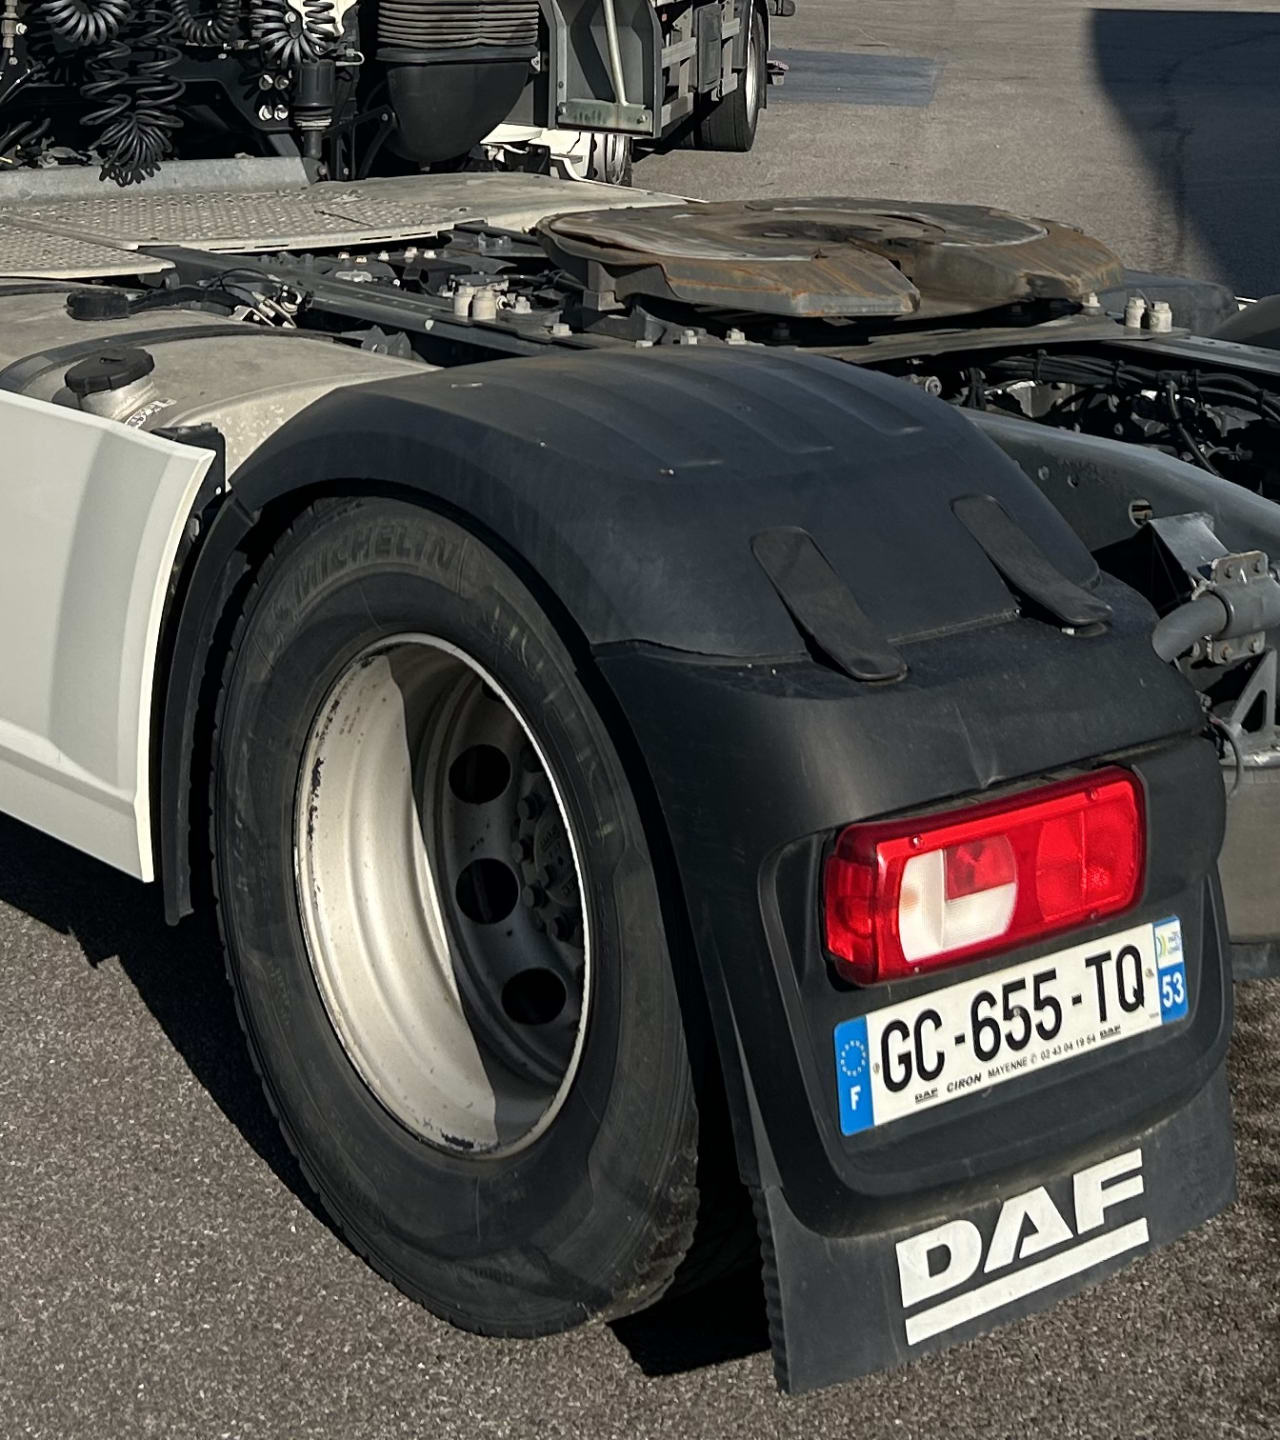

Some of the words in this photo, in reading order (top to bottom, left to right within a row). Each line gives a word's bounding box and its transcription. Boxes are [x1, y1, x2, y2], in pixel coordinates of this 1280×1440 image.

[295, 523, 459, 602] MICHELIN
[881, 944, 1145, 1093] GC-655-TQ
[1162, 971, 1185, 1008] 53
[850, 1085, 861, 1110] F
[946, 1072, 982, 1093] CIRON
[987, 1056, 1028, 1079] MAYENNE
[896, 1148, 1145, 1308] DAF
